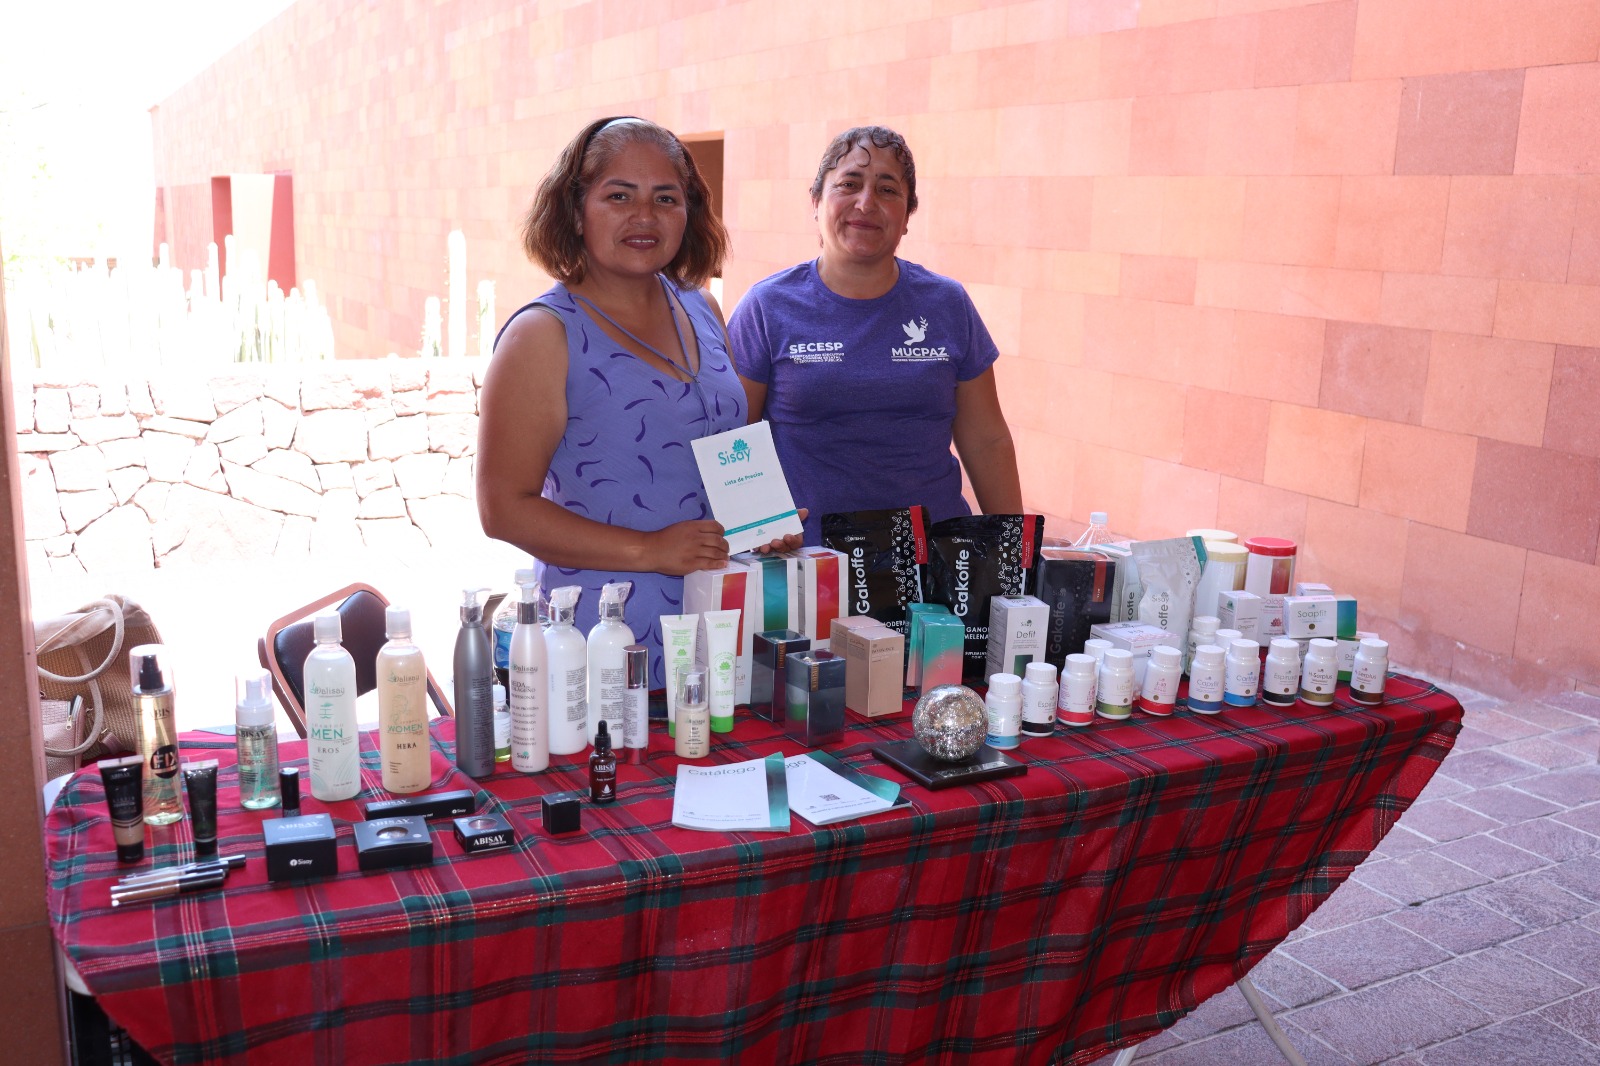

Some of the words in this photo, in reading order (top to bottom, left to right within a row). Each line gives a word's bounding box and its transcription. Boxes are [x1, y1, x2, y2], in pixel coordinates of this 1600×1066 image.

[789, 342, 844, 354] SECESP
[891, 347, 948, 357] MUCPAZ
[717, 448, 751, 466] Sisay
[724, 478, 737, 486] Lista
[737, 475, 744, 483] de
[744, 471, 764, 481] Precios
[851, 547, 870, 614] Gakoffe
[953, 549, 970, 617] Gakoffe
[1297, 609, 1327, 619] Soapfit
[1050, 601, 1066, 654] Gakoffe
[1016, 631, 1036, 639] Defit
[315, 686, 345, 697] Dalisay
[388, 723, 423, 733] WOMEN
[311, 728, 343, 740] MEN
[317, 746, 340, 754] EROS
[397, 742, 417, 750] HERA
[688, 766, 756, 778] Catálogo
[277, 820, 320, 830] ABISAY
[368, 818, 411, 828] ABISAY
[473, 834, 505, 846] ABISAY
[297, 858, 313, 866] Sisay
